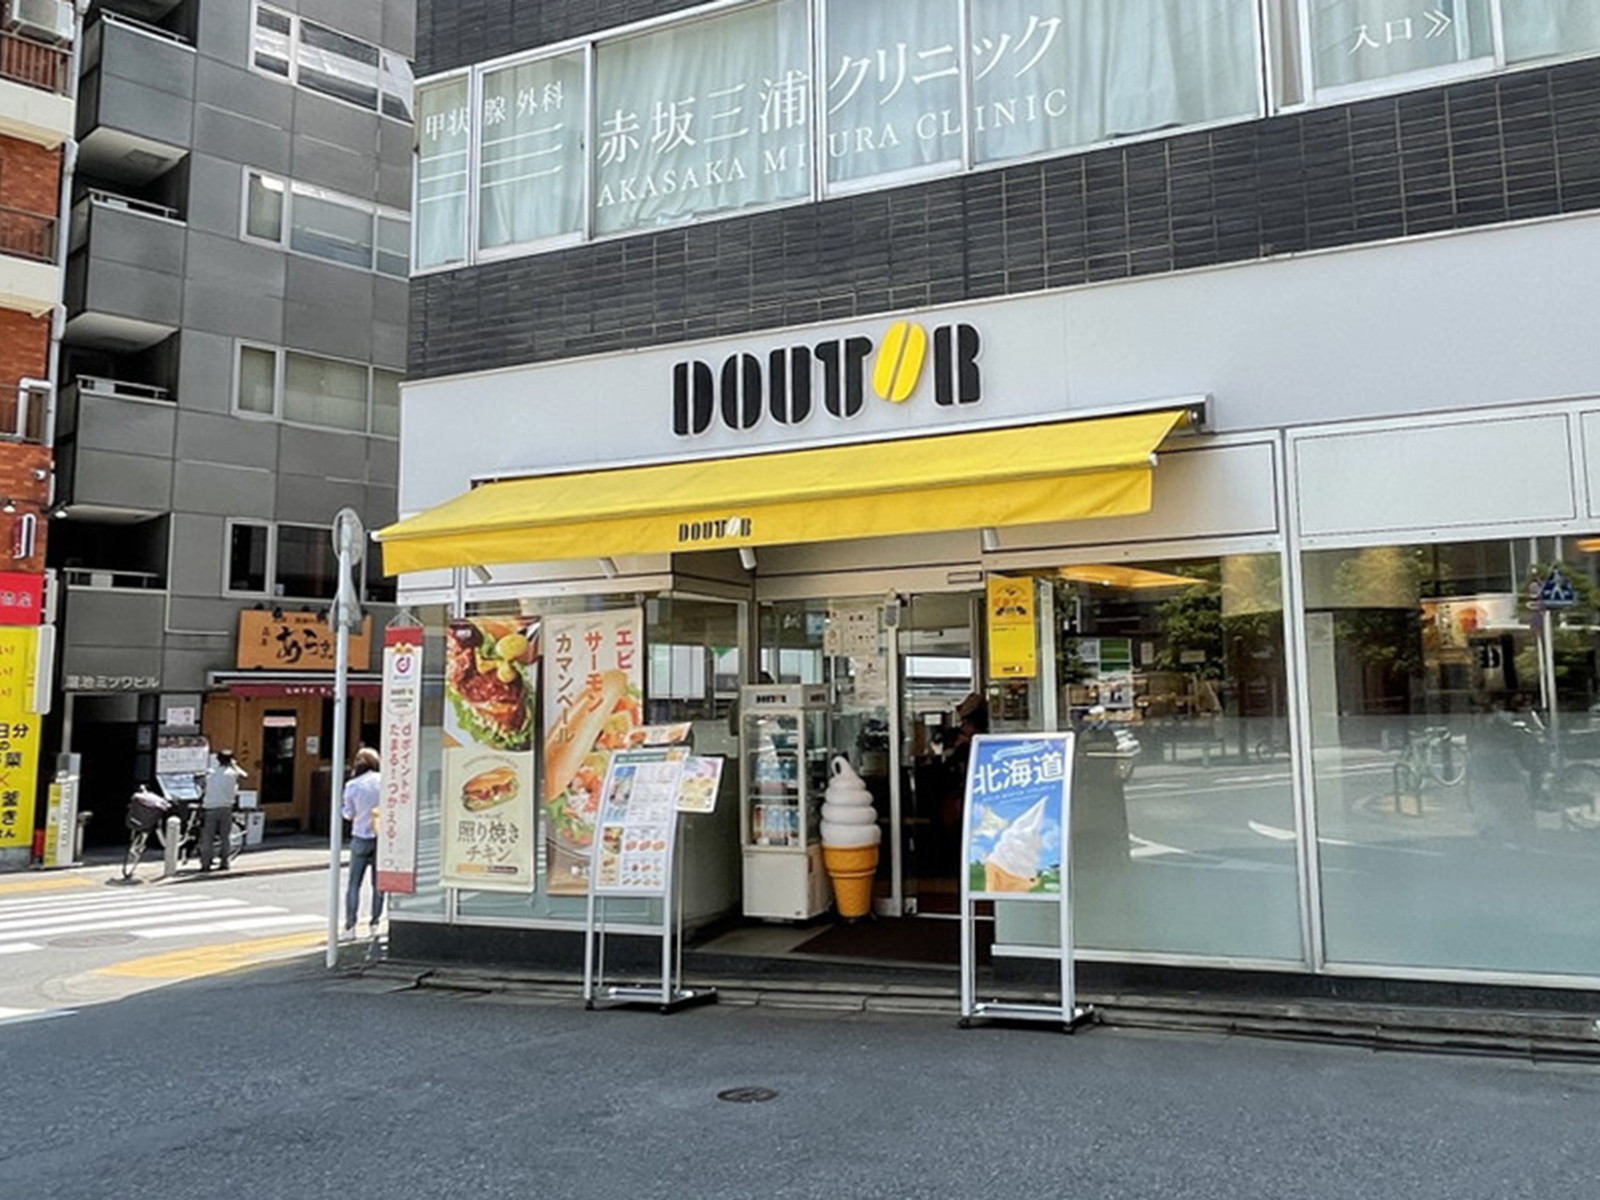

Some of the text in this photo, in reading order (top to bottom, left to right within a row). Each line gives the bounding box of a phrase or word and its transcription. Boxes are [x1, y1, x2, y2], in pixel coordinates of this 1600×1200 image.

[1349, 17, 1413, 54] 入口
[596, 15, 1062, 168] 赤坂三浦クリニック
[597, 88, 1069, 207] AKASAKA MIURA CLINIC
[672, 320, 982, 437] DOUTOR
[678, 516, 752, 542] DOUTOR
[584, 631, 604, 713] サーモン
[615, 629, 635, 670] エビ
[554, 633, 575, 744] カマンベール
[972, 750, 1066, 796] 北海道
[457, 820, 520, 844] 照り焼き
[465, 844, 512, 863] チキン
